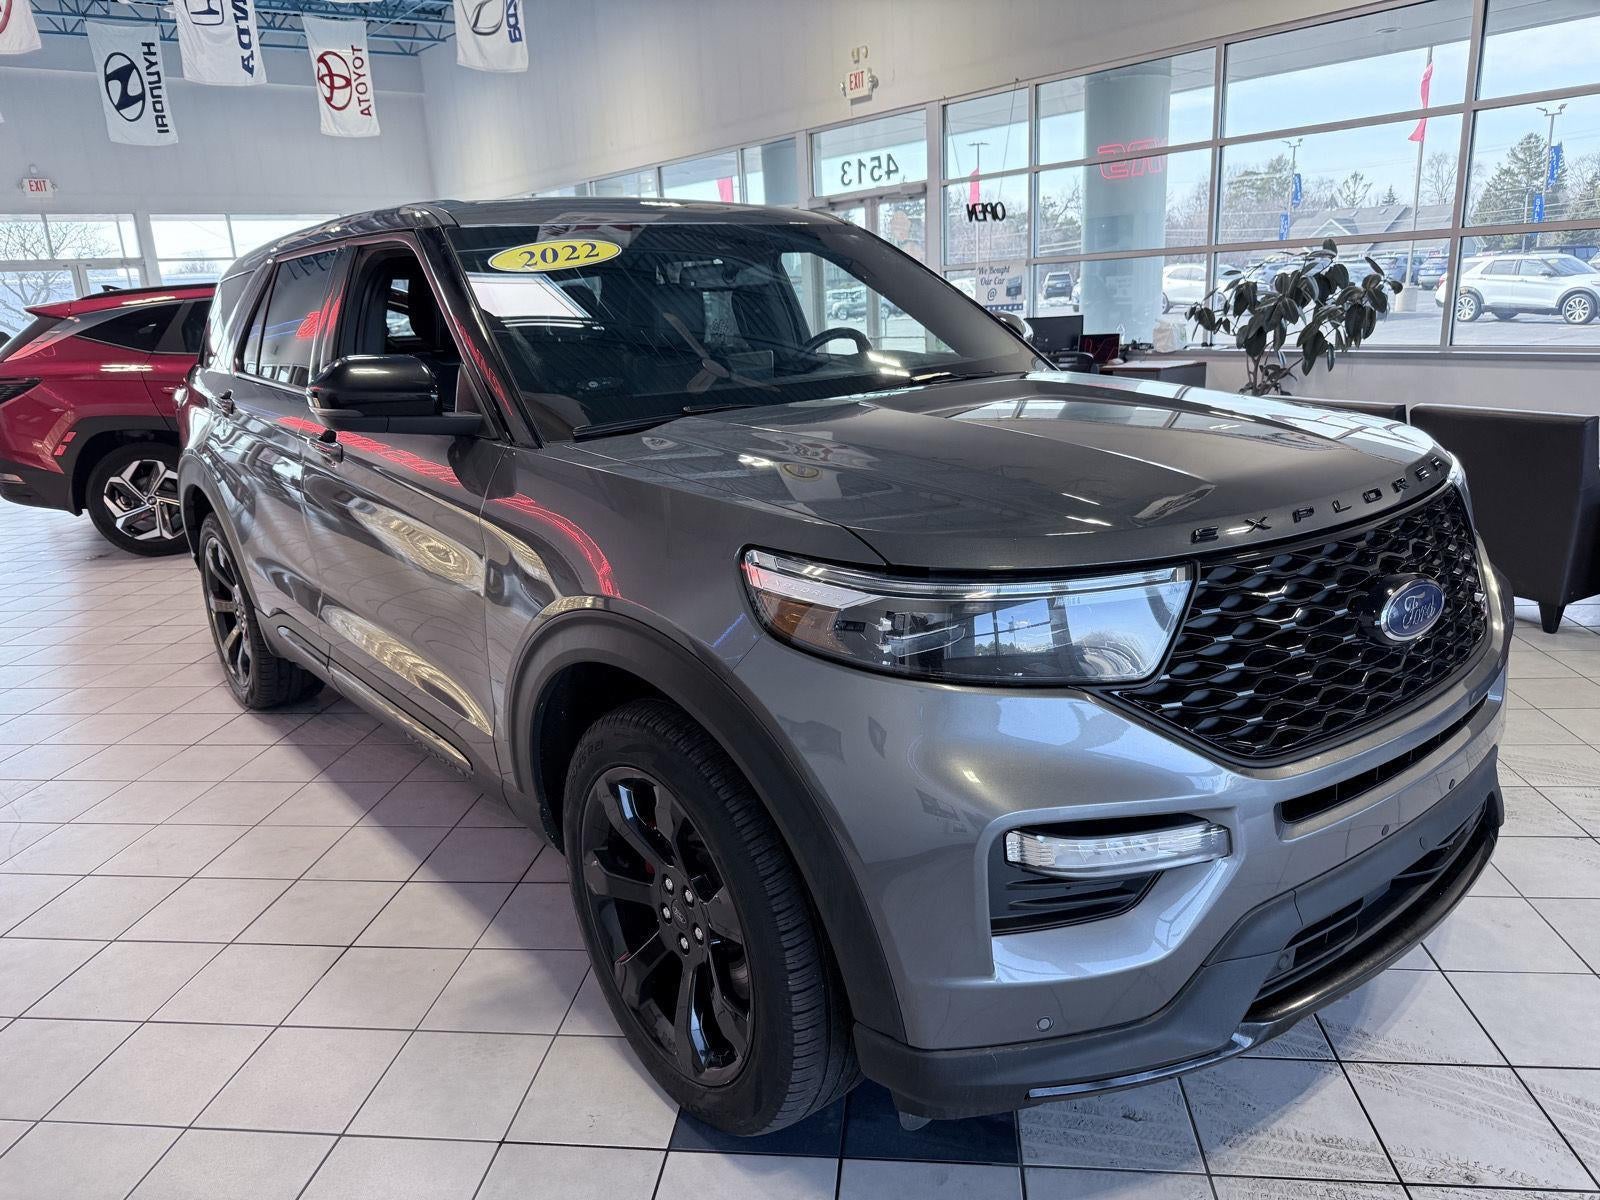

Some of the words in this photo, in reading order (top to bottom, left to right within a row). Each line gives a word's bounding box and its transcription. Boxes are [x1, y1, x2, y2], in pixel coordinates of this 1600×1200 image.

[849, 70, 865, 92] EXIT
[28, 179, 47, 193] EXIT
[518, 242, 600, 268] 2022
[977, 266, 988, 275] We
[980, 277, 993, 287] Our
[993, 276, 1006, 286] Car
[1190, 455, 1443, 545] EXPLORER
[1402, 591, 1436, 630] Ford
